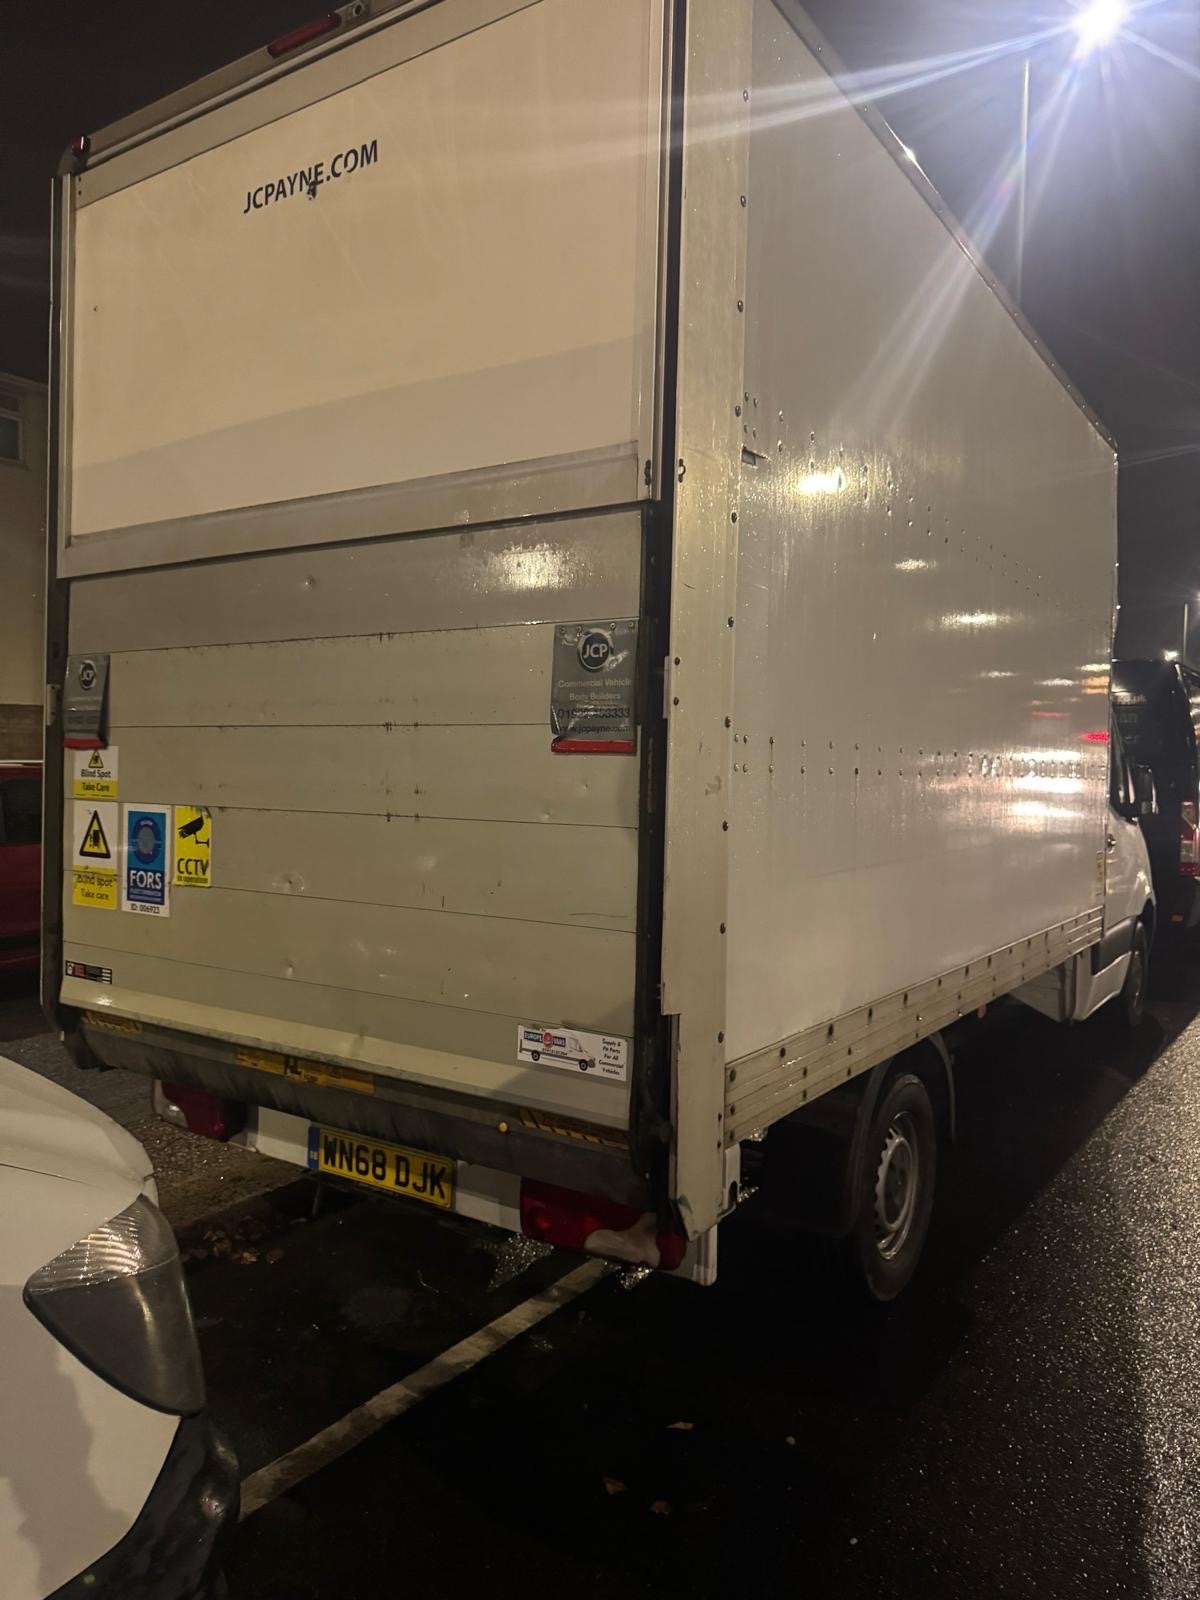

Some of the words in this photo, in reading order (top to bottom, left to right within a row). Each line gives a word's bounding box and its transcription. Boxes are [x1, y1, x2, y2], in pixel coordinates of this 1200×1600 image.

[243, 139, 378, 214] JCPAYNE.COM
[583, 643, 607, 658] JCP
[80, 769, 96, 777] Blind
[97, 769, 111, 779] Spot
[82, 782, 95, 791] Take
[96, 783, 110, 792] Care
[177, 858, 209, 876] CCTV
[96, 877, 112, 888] spot
[129, 870, 162, 890] FORS
[81, 888, 95, 898] Take
[96, 892, 109, 901] care
[524, 1032, 542, 1042] EUROPE
[602, 1038, 616, 1047] Supply
[610, 1047, 620, 1055] Parts
[598, 1059, 624, 1069] Commercial
[602, 1067, 620, 1076] Vehicles
[323, 1135, 387, 1181] WN68
[395, 1154, 446, 1199] DJK
